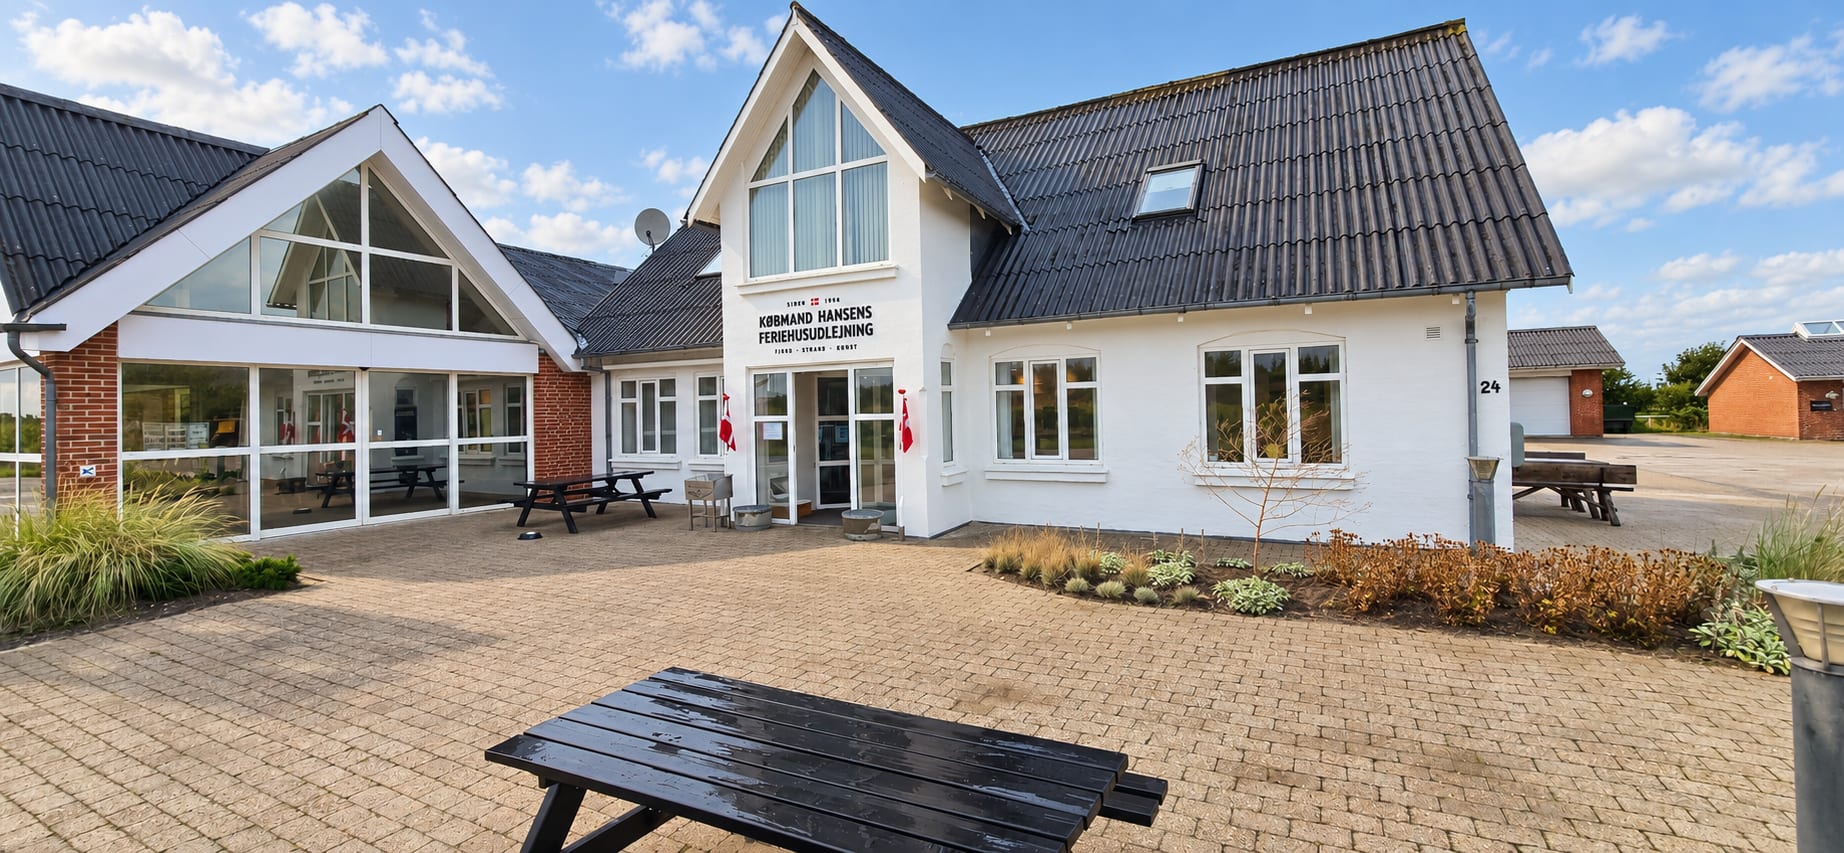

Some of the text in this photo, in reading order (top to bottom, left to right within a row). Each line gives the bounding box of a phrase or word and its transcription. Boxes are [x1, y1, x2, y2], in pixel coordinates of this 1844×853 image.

[759, 305, 873, 328] KØBMAND HANSENS
[759, 323, 874, 344] FERIEHUSUDLEJNING
[1480, 380, 1501, 394] 24
